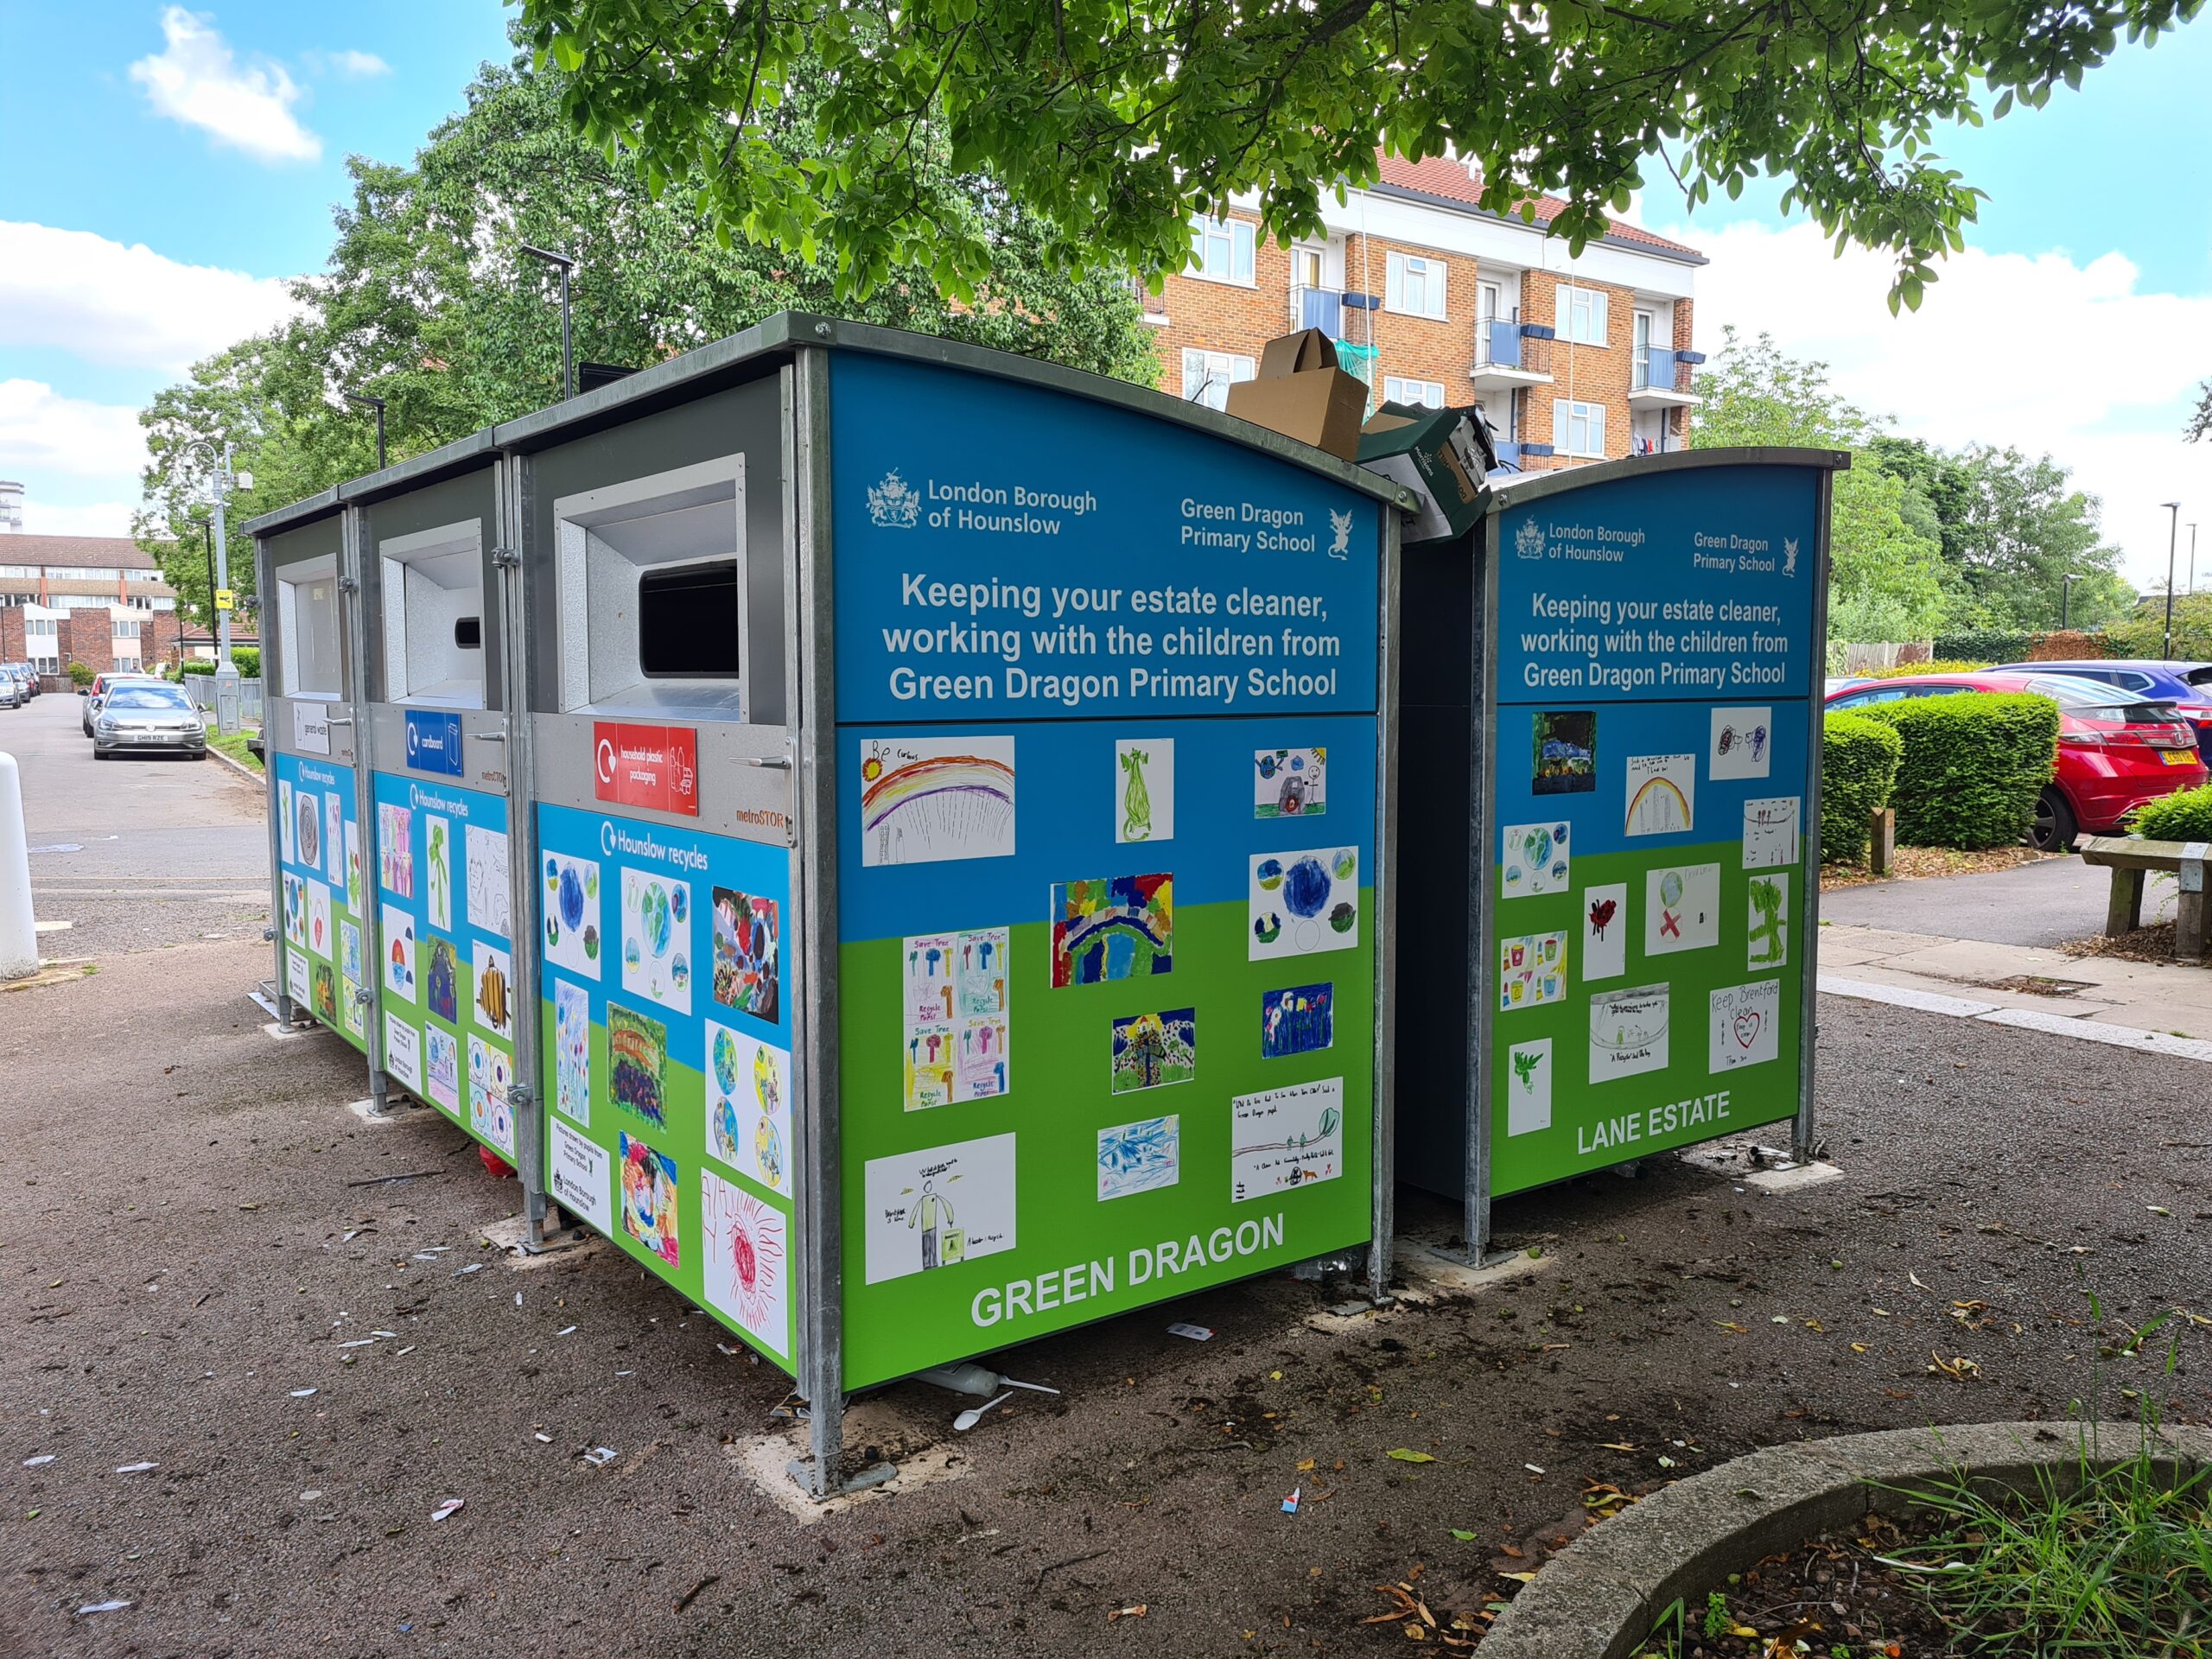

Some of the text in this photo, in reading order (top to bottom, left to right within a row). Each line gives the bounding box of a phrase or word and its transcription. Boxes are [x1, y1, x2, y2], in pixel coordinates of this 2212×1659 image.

[1414, 446, 1433, 476] Morrisons
[928, 479, 1097, 515] London Borough
[928, 509, 1061, 536] of Hounslow
[1180, 498, 1304, 526] Green Dragon
[1180, 525, 1316, 553] Primary School
[1549, 523, 1645, 544] London Borough
[1694, 532, 1769, 555] Green Dragon
[1548, 543, 1624, 563] of Hounslow
[1694, 553, 1775, 574] Primary School
[902, 573, 1328, 622] Keeping your estate cleaner,
[1533, 593, 1781, 626] Keeping your estate cleaner,
[883, 622, 1341, 663] working with the children from
[1522, 628, 1789, 658] working with the children from
[889, 667, 1337, 707] Green Dragon Primary School
[1524, 662, 1785, 691] Green Dragon Primary School
[422, 734, 442, 750] cardboard
[620, 745, 663, 764] household plastic
[873, 741, 890, 761] Be
[630, 766, 656, 786] packaging
[419, 790, 468, 818] Hounslow recycles
[736, 809, 784, 829] metroSTOR
[618, 830, 708, 872] Hounslow recycles
[919, 1003, 940, 1015] Recycle
[1712, 982, 1778, 1013] Keep Brentford
[1730, 1005, 1752, 1020] clean
[920, 1089, 941, 1101] Recycle
[1578, 1090, 1730, 1154] LANE ESTATE
[563, 1150, 588, 1172] Primary School
[564, 1141, 585, 1160] Green Dragon
[563, 1175, 596, 1206] London Borough
[564, 1188, 589, 1211] of Hounslow
[971, 1212, 1283, 1327] GREEN DRAGON
